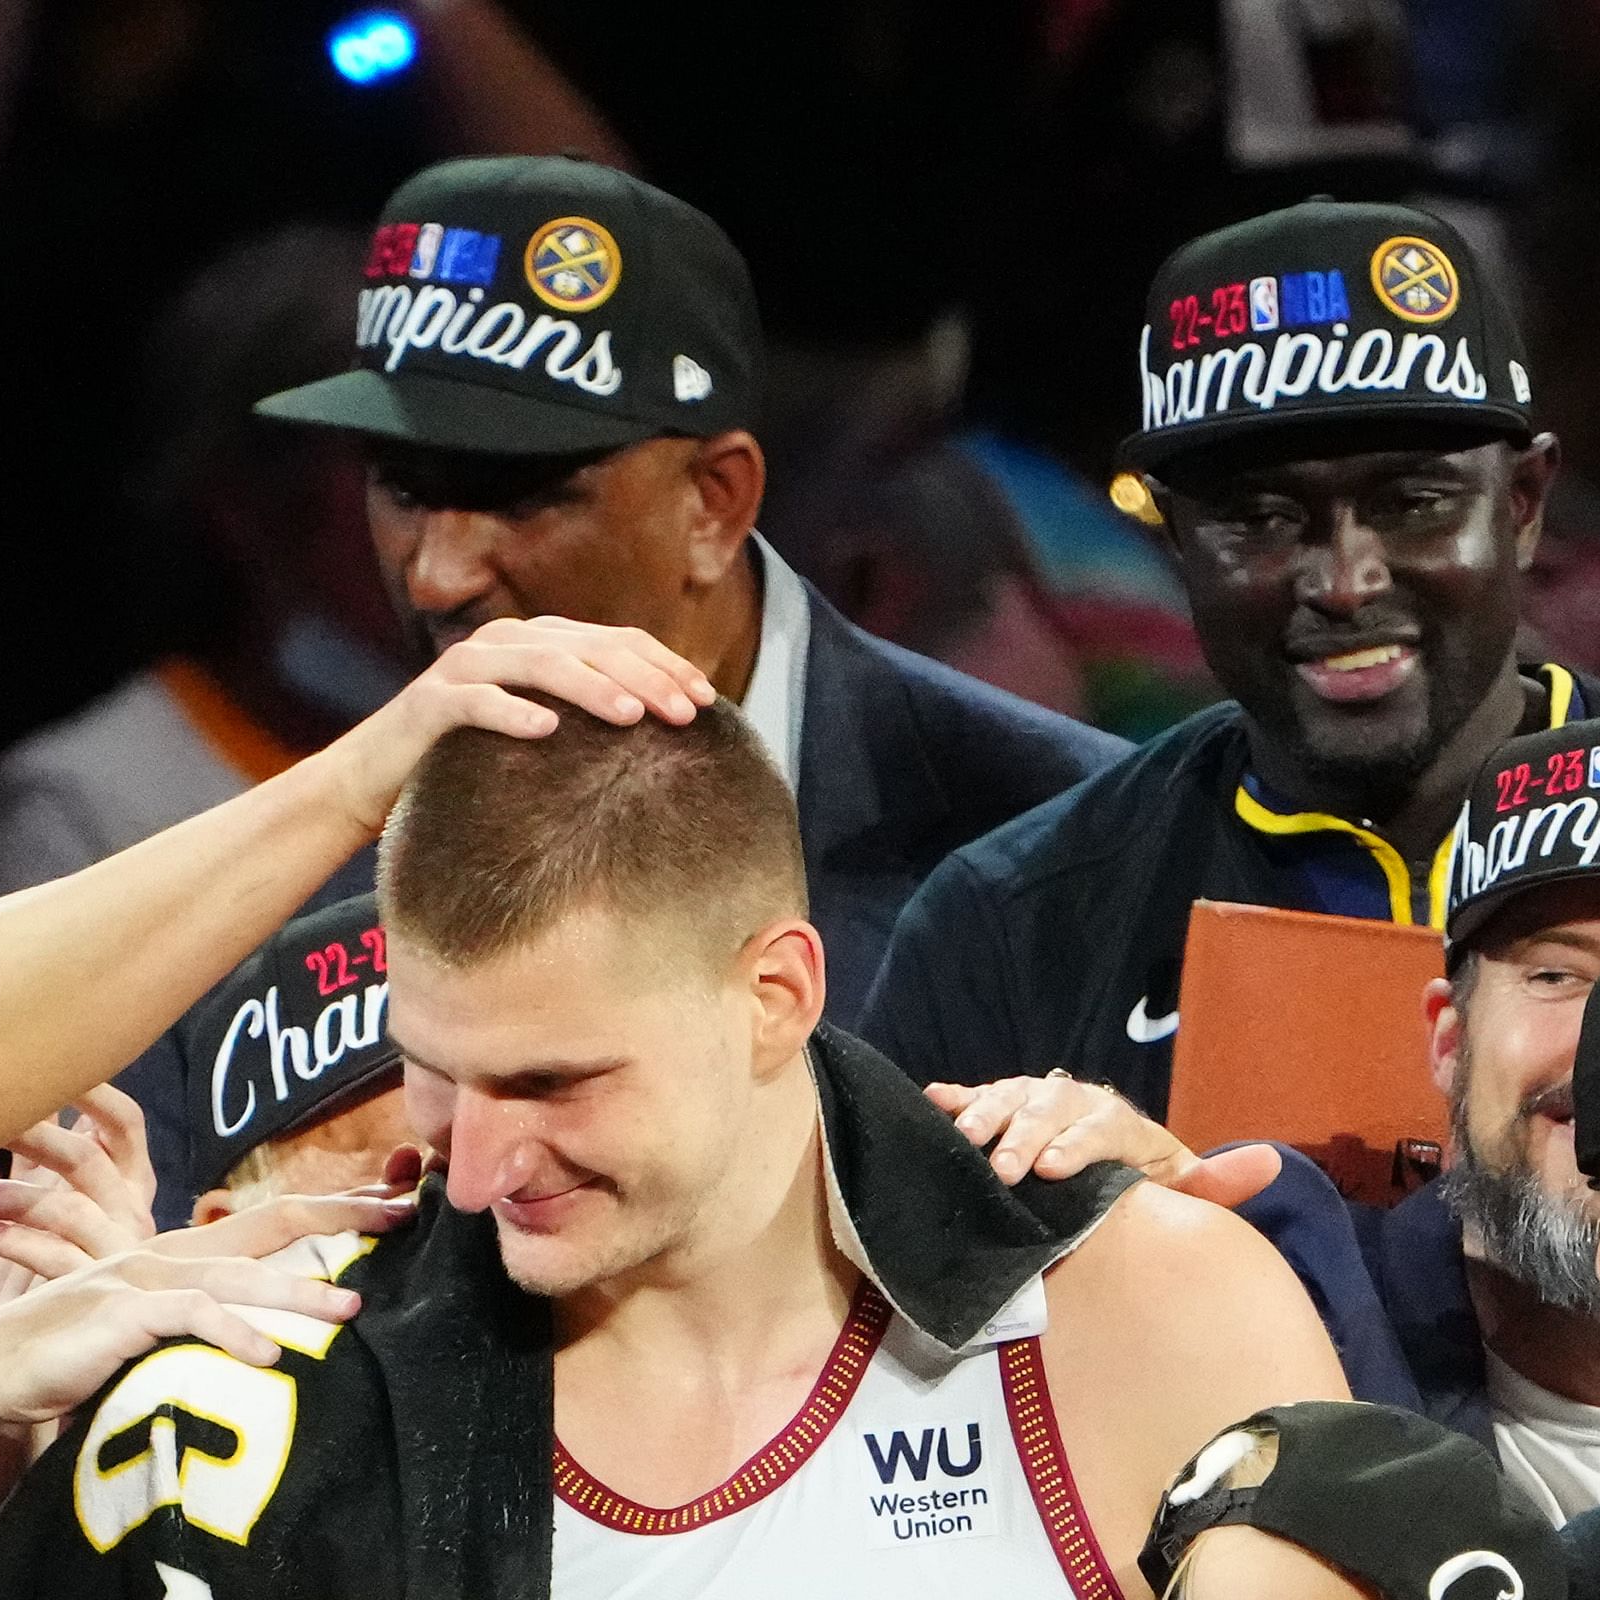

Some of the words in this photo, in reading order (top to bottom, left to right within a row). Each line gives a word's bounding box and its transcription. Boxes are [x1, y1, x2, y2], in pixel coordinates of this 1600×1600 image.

[1169, 282, 1248, 350] 22-23
[1495, 748, 1585, 813] 22-23
[863, 1422, 983, 1485] WU
[870, 1487, 988, 1517] Western
[893, 1513, 973, 1540] Union
